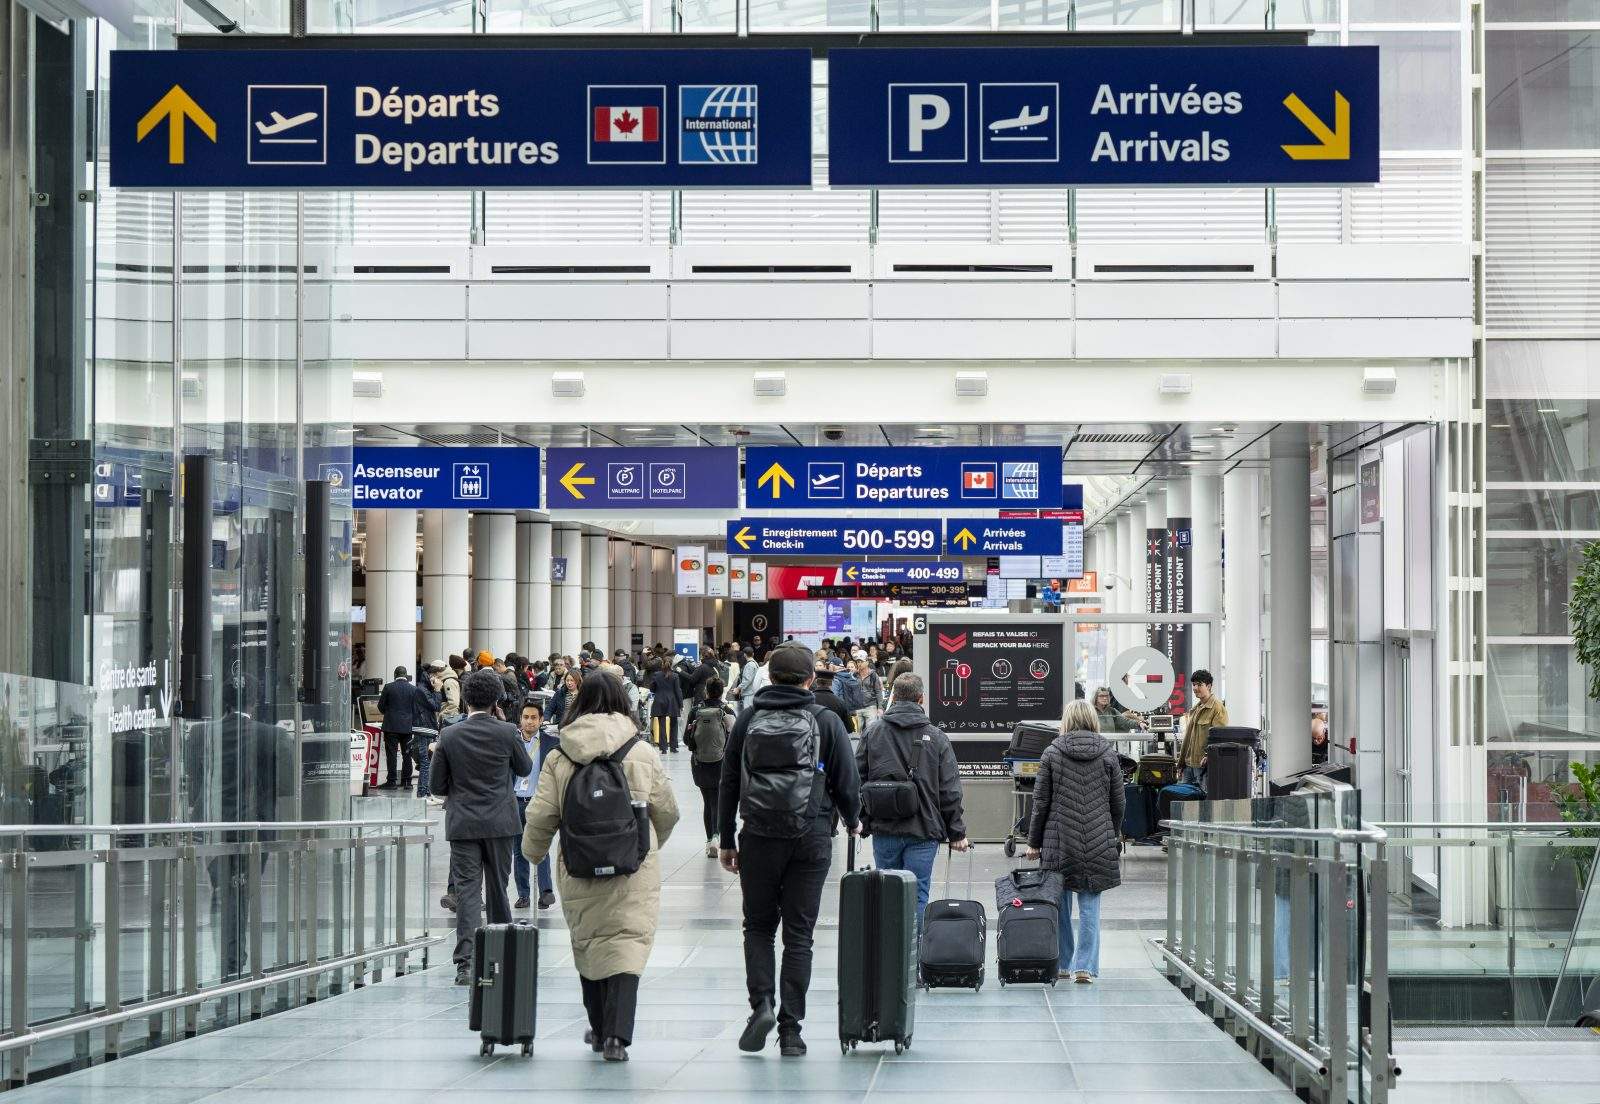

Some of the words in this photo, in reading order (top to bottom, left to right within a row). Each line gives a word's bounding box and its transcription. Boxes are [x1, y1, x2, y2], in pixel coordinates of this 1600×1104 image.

[354, 86, 500, 123] Départs
[1091, 82, 1243, 116] Arrivées
[685, 117, 751, 130] International
[908, 93, 951, 152] P
[354, 134, 560, 171] Departures
[1091, 129, 1231, 163] Arrivals
[353, 464, 440, 479] Ascenseur
[856, 462, 922, 480] Départs
[353, 484, 423, 500] Elevator
[856, 485, 949, 501] Departures
[762, 527, 838, 541] Enregistrement
[843, 530, 935, 549] 500-599
[983, 527, 1026, 538] Arrivées
[762, 540, 804, 549] Check-in
[983, 541, 1023, 550] Arrivals
[907, 568, 959, 579] 400-499
[1154, 562, 1162, 591] POINT
[1175, 556, 1184, 587] POINT
[931, 586, 965, 595] 300-399
[1154, 591, 1162, 631] MTING
[1175, 588, 1184, 631] MTING
[914, 617, 926, 631] 6
[100, 662, 125, 690] Centre
[126, 661, 136, 688] de
[136, 659, 157, 687] santé
[107, 705, 133, 733] Health
[133, 704, 157, 730] centre
